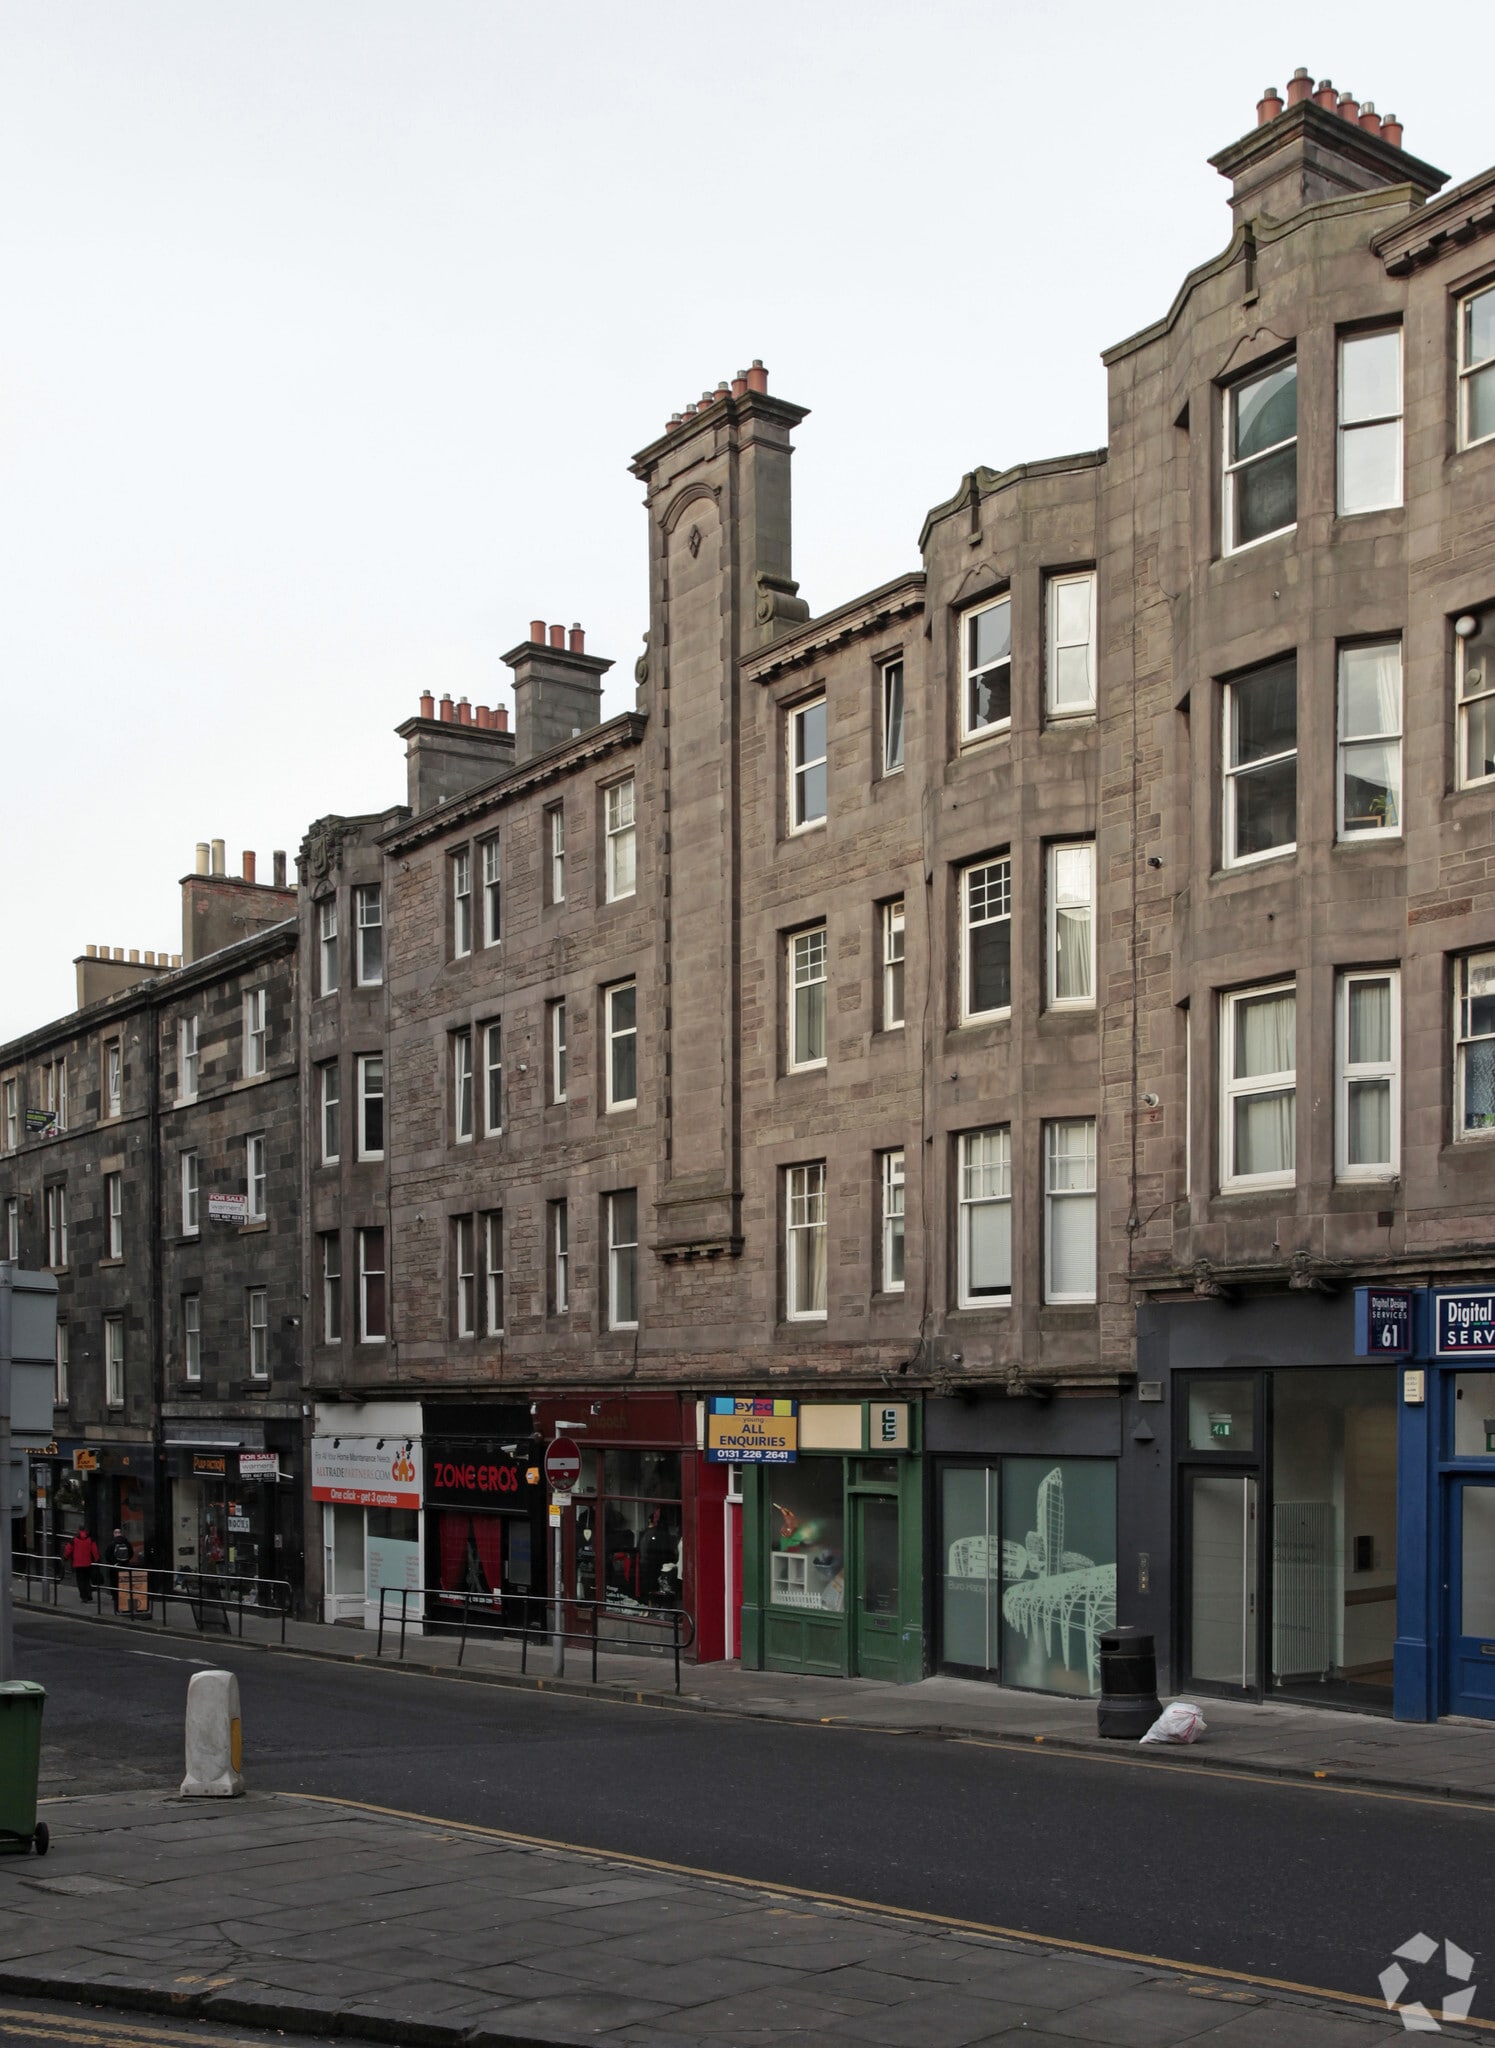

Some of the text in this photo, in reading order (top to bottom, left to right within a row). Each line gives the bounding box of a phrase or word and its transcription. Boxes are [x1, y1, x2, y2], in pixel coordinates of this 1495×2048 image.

[1372, 1297, 1407, 1312] Digital Design
[1372, 1311, 1408, 1319] SERVICES
[1448, 1299, 1492, 1328] Digital
[1381, 1323, 1398, 1347] 61
[735, 1402, 773, 1412] eyco
[742, 1424, 765, 1434] ALL
[720, 1435, 786, 1448] ENQUIRIES
[337, 1453, 349, 1461] Home
[350, 1453, 376, 1462] Maintenance
[717, 1450, 788, 1460] 0131 226 2641
[433, 1461, 518, 1492] ZONE EROS
[330, 1488, 343, 1500] One
[343, 1489, 357, 1501] click
[360, 1491, 371, 1504] get
[371, 1491, 376, 1502] 3
[376, 1492, 398, 1504] quotes
